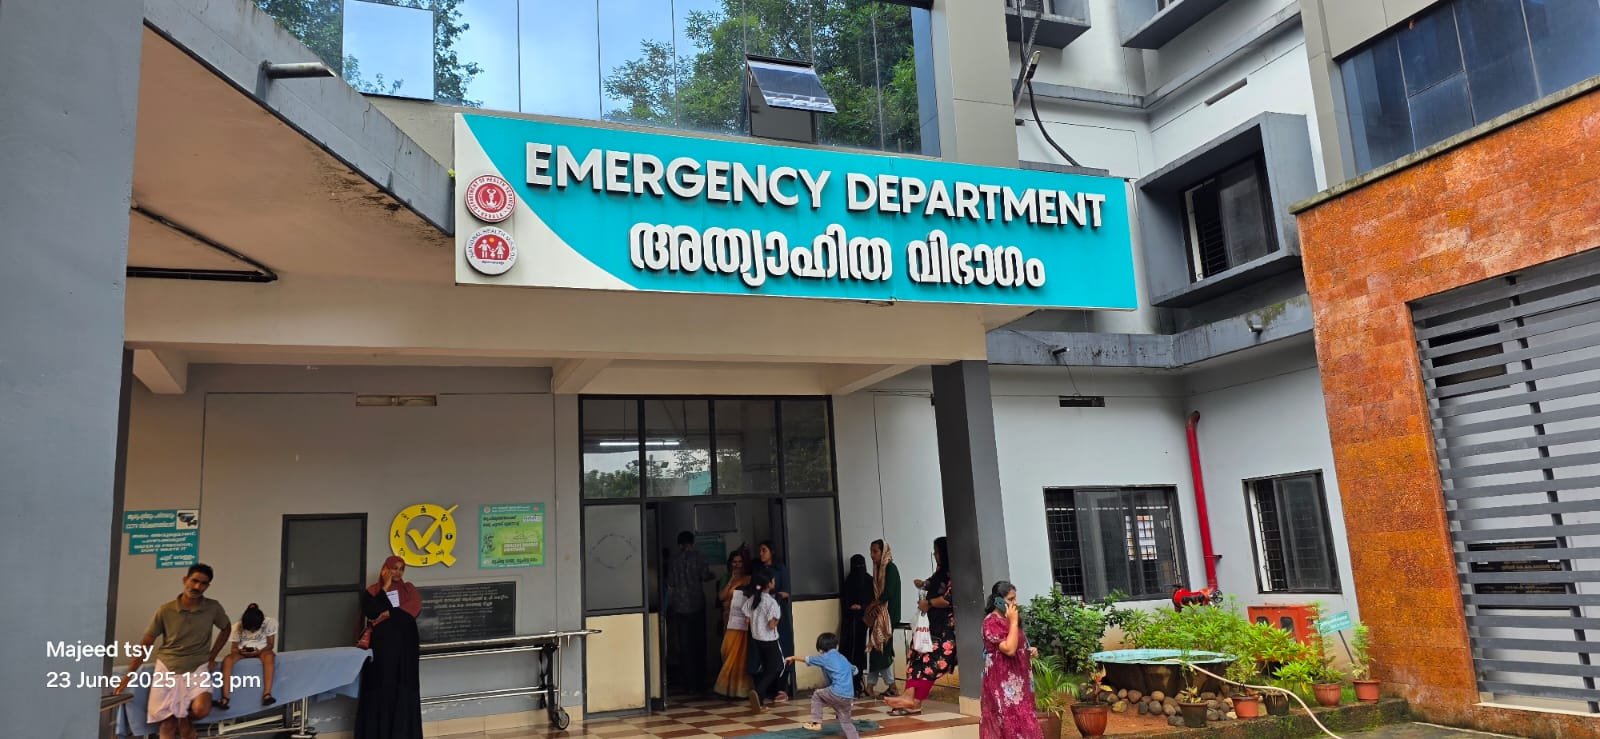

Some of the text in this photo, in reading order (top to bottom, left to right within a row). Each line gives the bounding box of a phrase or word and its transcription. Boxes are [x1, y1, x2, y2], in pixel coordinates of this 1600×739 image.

[524, 142, 1106, 229] EMERGENCY DEPARTMENT
[629, 222, 1047, 287] അത്യാഹിത വിഭാഗം
